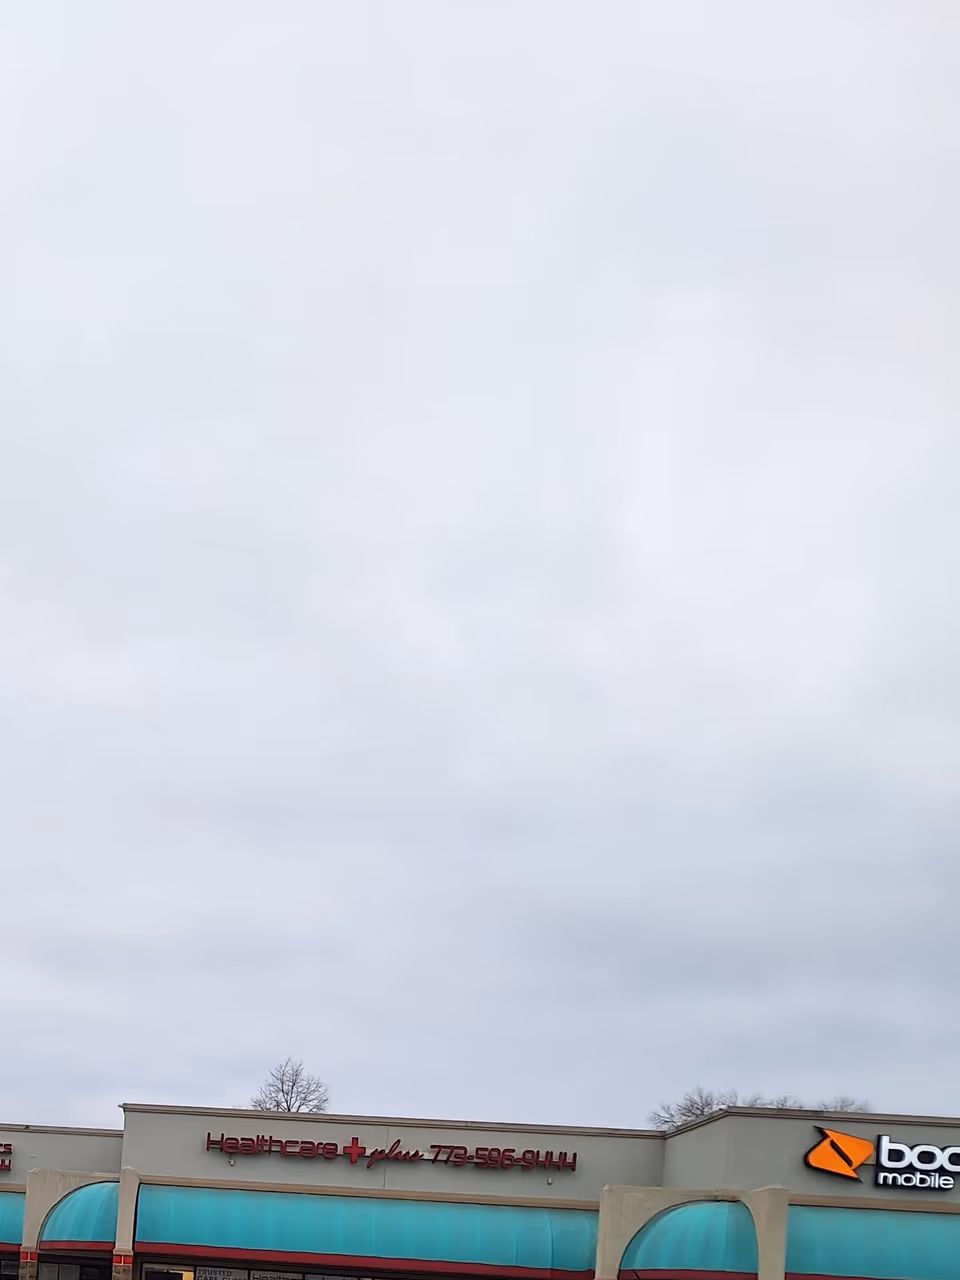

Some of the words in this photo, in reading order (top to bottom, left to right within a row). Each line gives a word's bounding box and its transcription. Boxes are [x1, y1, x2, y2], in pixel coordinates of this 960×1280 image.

[206, 1132, 338, 1159] Healthcare
[367, 1139, 424, 1168] plus
[429, 1145, 578, 1172] 773-596-9444
[877, 1172, 954, 1188] mobile
[197, 1268, 232, 1277] TRUSTED
